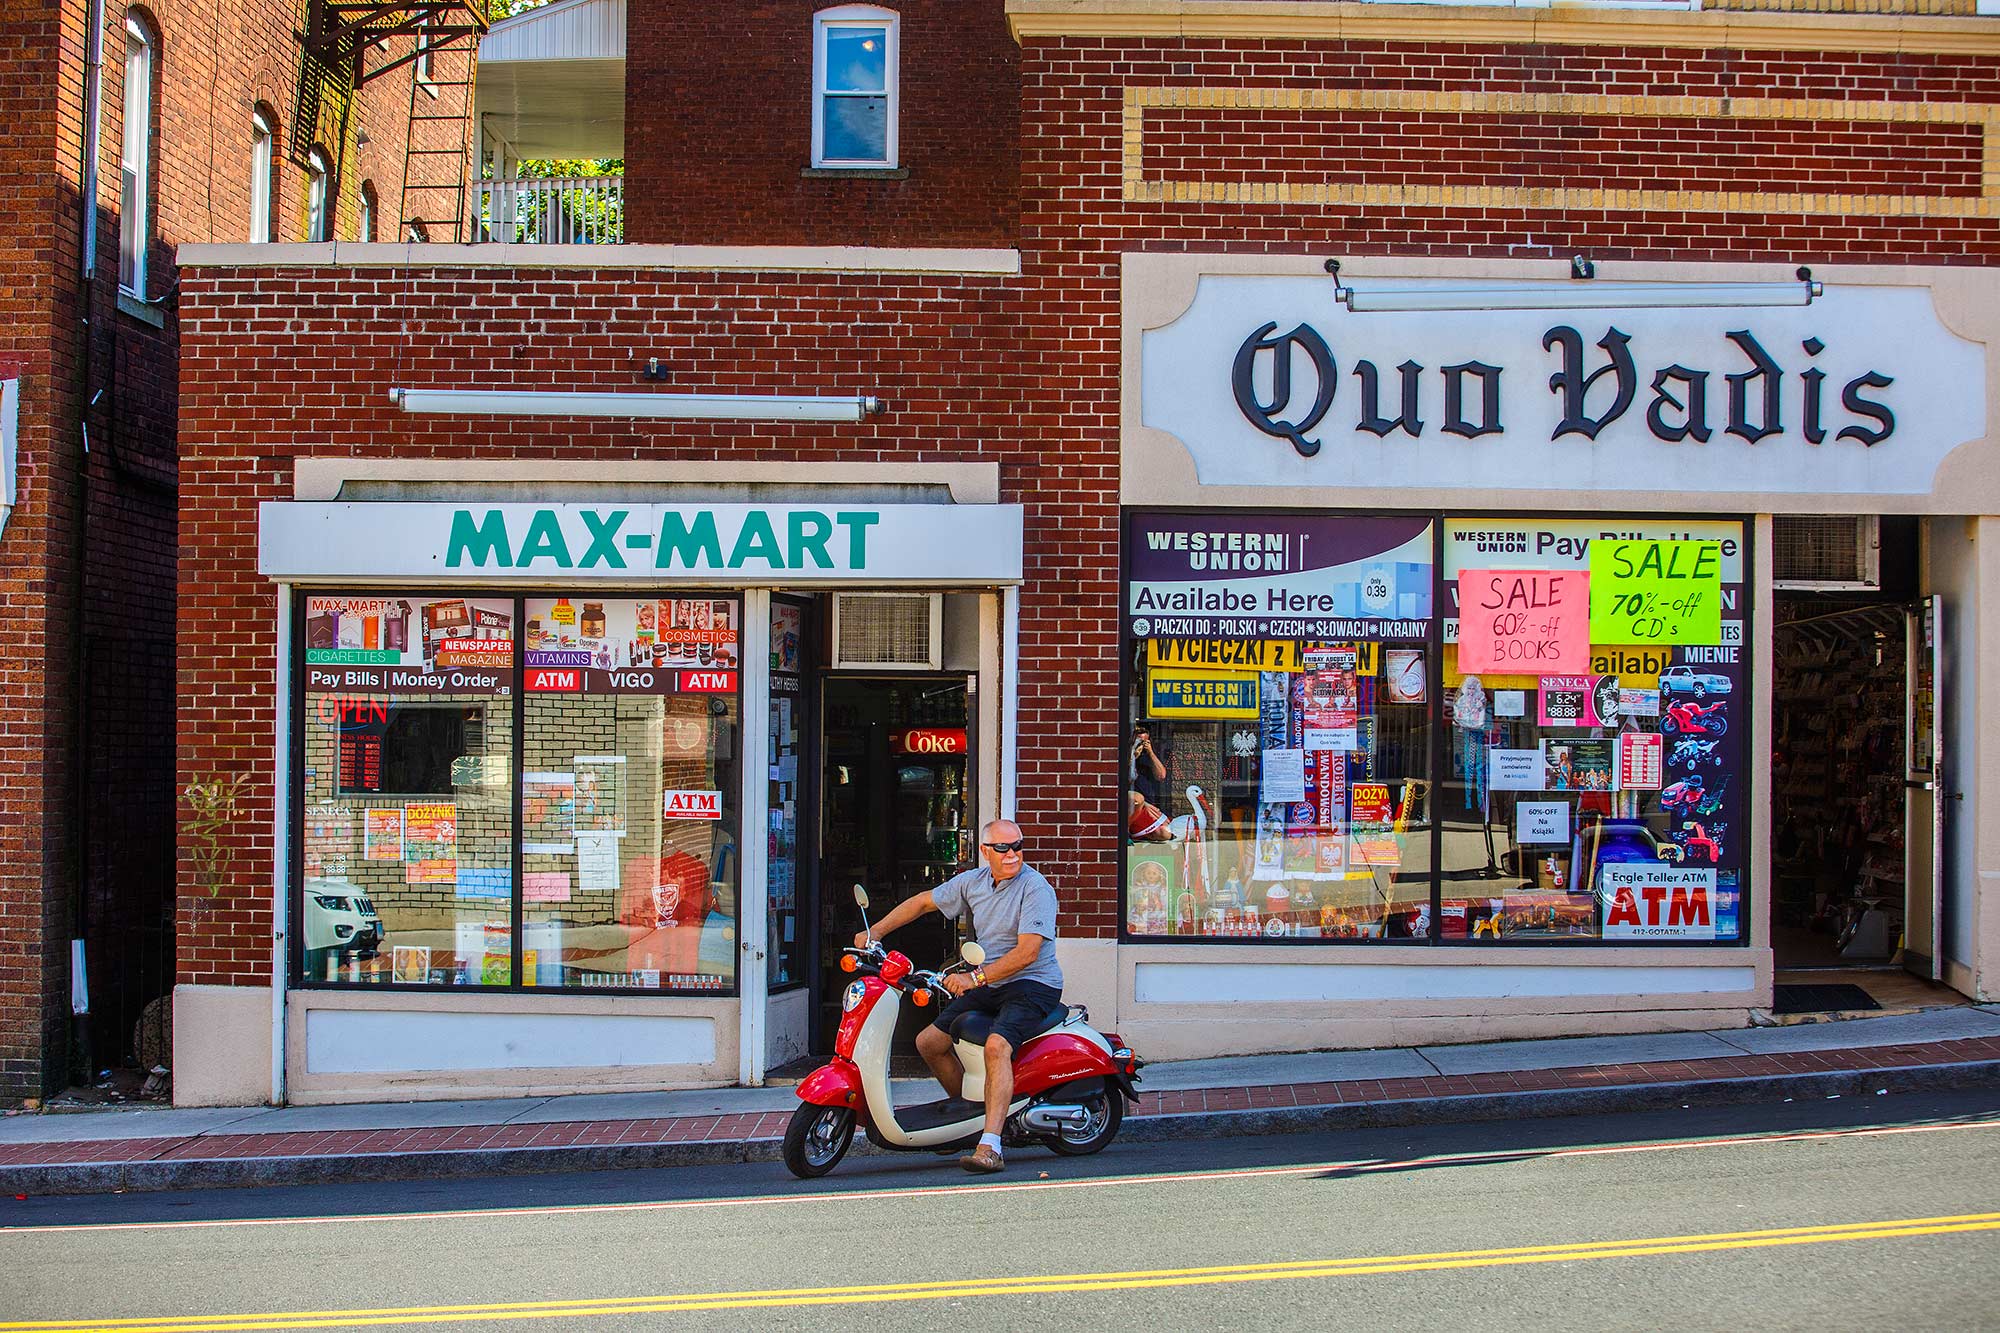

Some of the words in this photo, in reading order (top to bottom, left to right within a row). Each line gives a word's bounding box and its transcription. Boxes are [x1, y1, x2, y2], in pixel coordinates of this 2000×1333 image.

[1231, 320, 1505, 457] Quo
[1541, 325, 1896, 447] Vadis
[445, 509, 880, 570] MAX-MART
[1147, 532, 1283, 551] WESTERN
[1453, 532, 1527, 542] WESTERN
[1477, 542, 1527, 553] UNION
[1536, 531, 1591, 560] Pay
[1189, 552, 1283, 571] UNION
[1612, 543, 1719, 580] SALE
[1366, 585, 1387, 597] 0.39
[1480, 576, 1564, 610] SALE
[311, 600, 387, 611] MAX-MART
[1135, 587, 1257, 611] Availabe
[1267, 588, 1334, 612] Here
[1154, 619, 1194, 635] PACZKI
[1195, 619, 1210, 635] DO
[1219, 620, 1257, 636] POLSKI
[1270, 620, 1305, 637] CZECH
[1315, 621, 1369, 638] SŁOWACJI
[1379, 622, 1427, 638] UKRAINY
[665, 631, 736, 642] COSMETICS
[445, 641, 512, 651] NEWSPAPER
[1493, 639, 1561, 662] BOOKS
[307, 651, 386, 663] CIGARETTES
[449, 654, 512, 665] MAGAZINE
[527, 653, 590, 665] VITAMINS
[1684, 646, 1740, 664] MIENIE
[310, 671, 341, 688] Pay
[345, 671, 380, 686] Bills
[392, 673, 448, 690] Money
[451, 673, 498, 687] Order
[534, 672, 574, 687] ATM
[608, 673, 655, 688] VIGO
[687, 674, 728, 688] ATM
[1540, 677, 1591, 688] SENECA
[1155, 682, 1239, 694] WESTERN
[1182, 694, 1239, 706] UNION
[1556, 694, 1577, 704] 6.24
[317, 693, 389, 725] OPEN
[904, 730, 956, 753] Coke
[1334, 755, 1345, 807] ROBERT
[669, 793, 717, 810] ATM
[305, 807, 351, 816] SENECA
[407, 805, 455, 820] DOŻYNKI
[1528, 808, 1559, 816] 60%-OFF
[1612, 872, 1644, 884] Eagle
[1647, 872, 1679, 882] Teller
[1681, 873, 1708, 883] ATM
[1606, 886, 1711, 926] ATM
